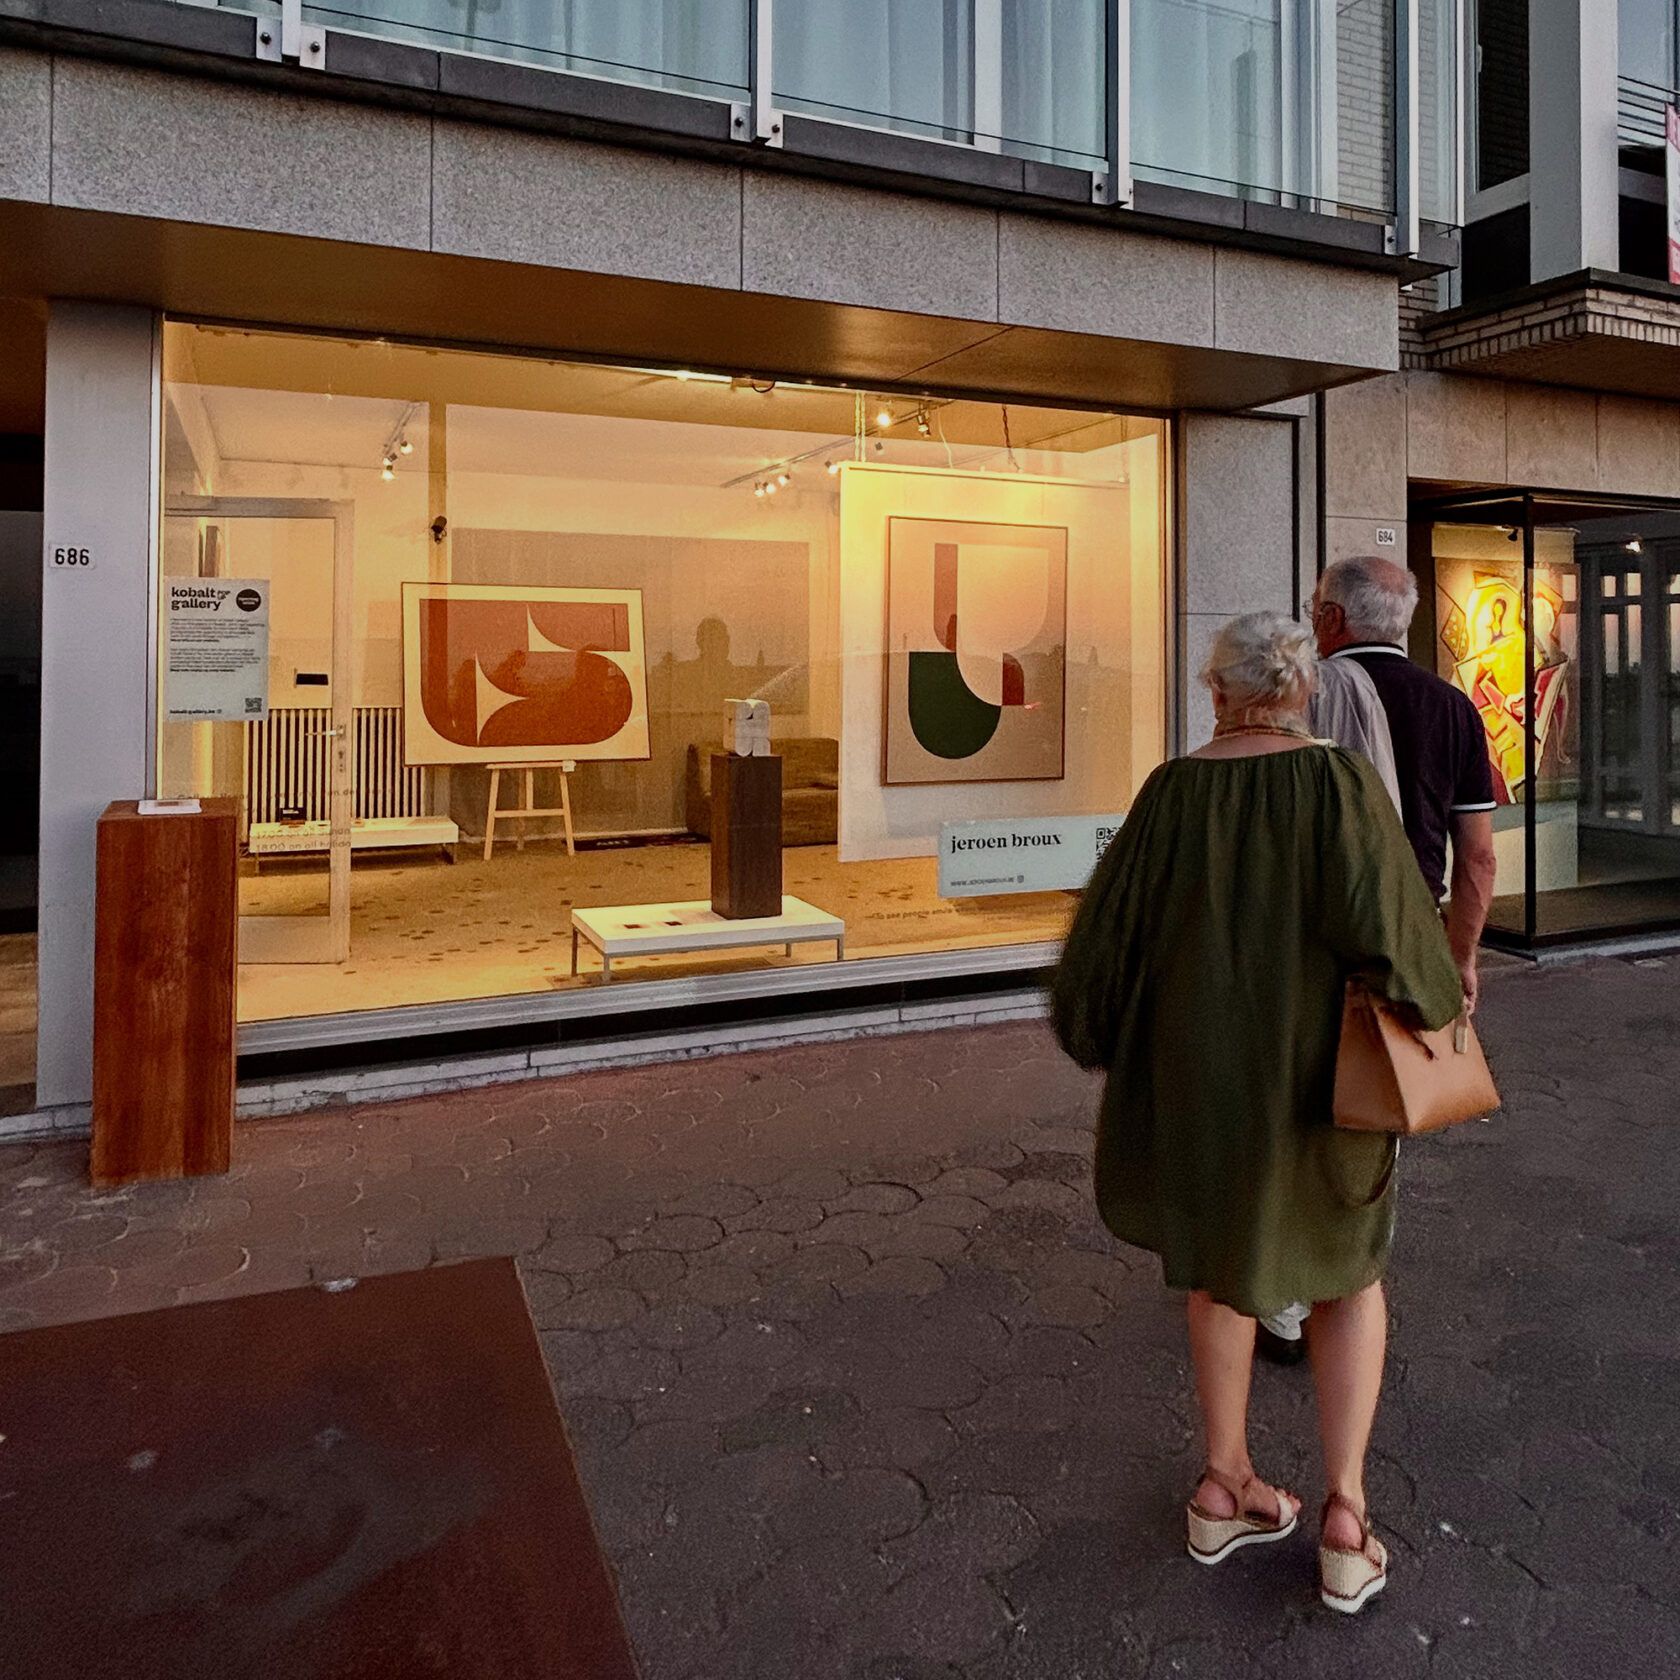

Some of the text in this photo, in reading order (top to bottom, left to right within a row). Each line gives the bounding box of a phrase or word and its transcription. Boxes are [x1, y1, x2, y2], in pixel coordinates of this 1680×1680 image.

[1378, 530, 1393, 543] 684
[55, 547, 89, 566] 686
[171, 586, 216, 598] kobalt
[171, 599, 222, 611] gallery
[951, 833, 1062, 854] jeroen broux
